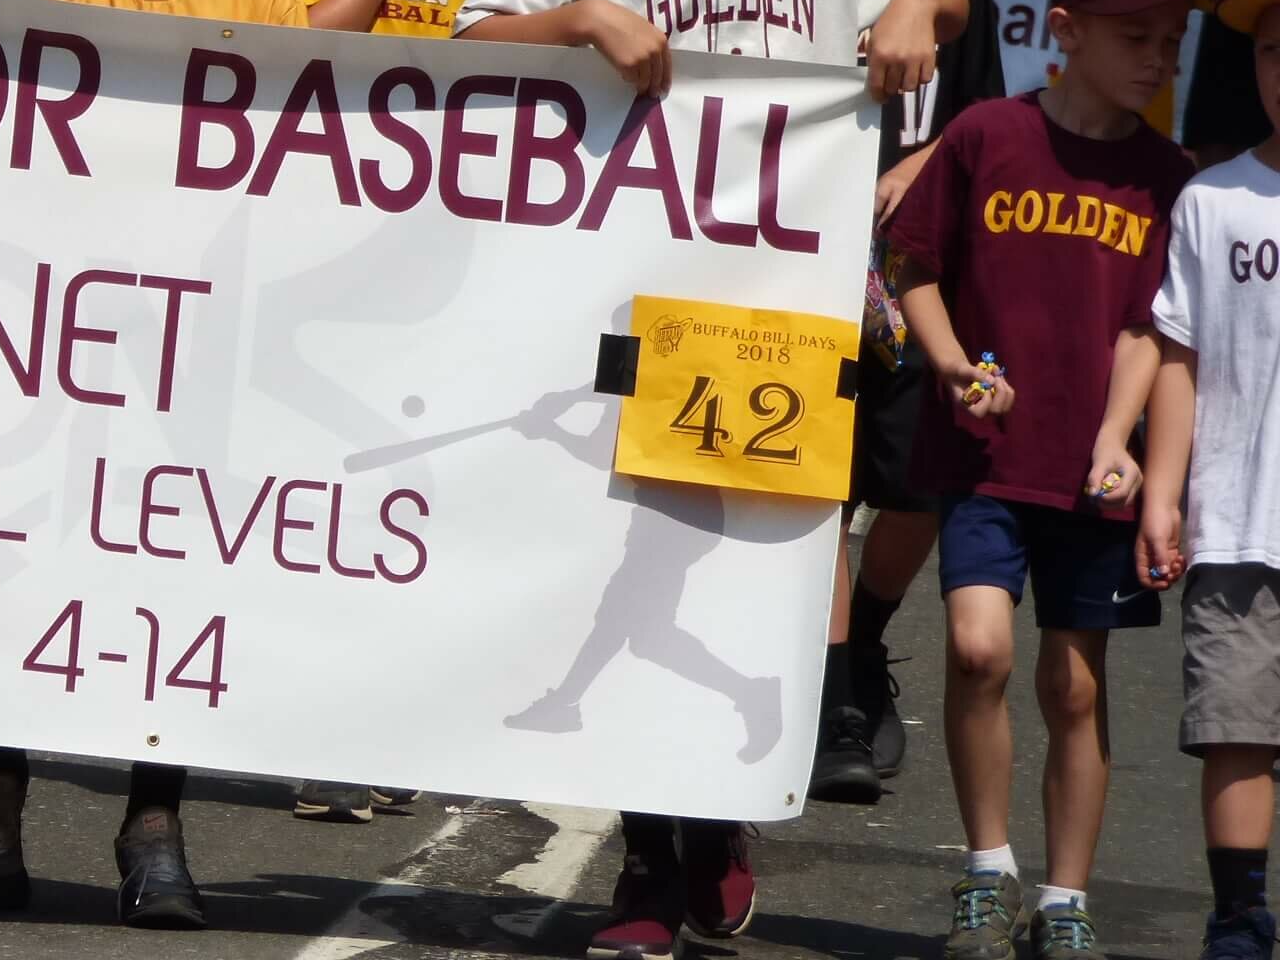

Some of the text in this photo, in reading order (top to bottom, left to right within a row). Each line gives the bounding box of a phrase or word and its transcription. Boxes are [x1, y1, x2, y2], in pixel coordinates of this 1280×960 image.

[176, 46, 819, 253] BASEBALL
[984, 190, 1152, 256] GOLDEN
[693, 322, 758, 341] BUFFALO
[763, 331, 794, 345] BILL
[799, 335, 837, 351] DAYS
[737, 343, 791, 365] 2018
[669, 375, 805, 466] 42
[91, 458, 429, 583] LEVELS
[23, 600, 227, 708] 4-14
